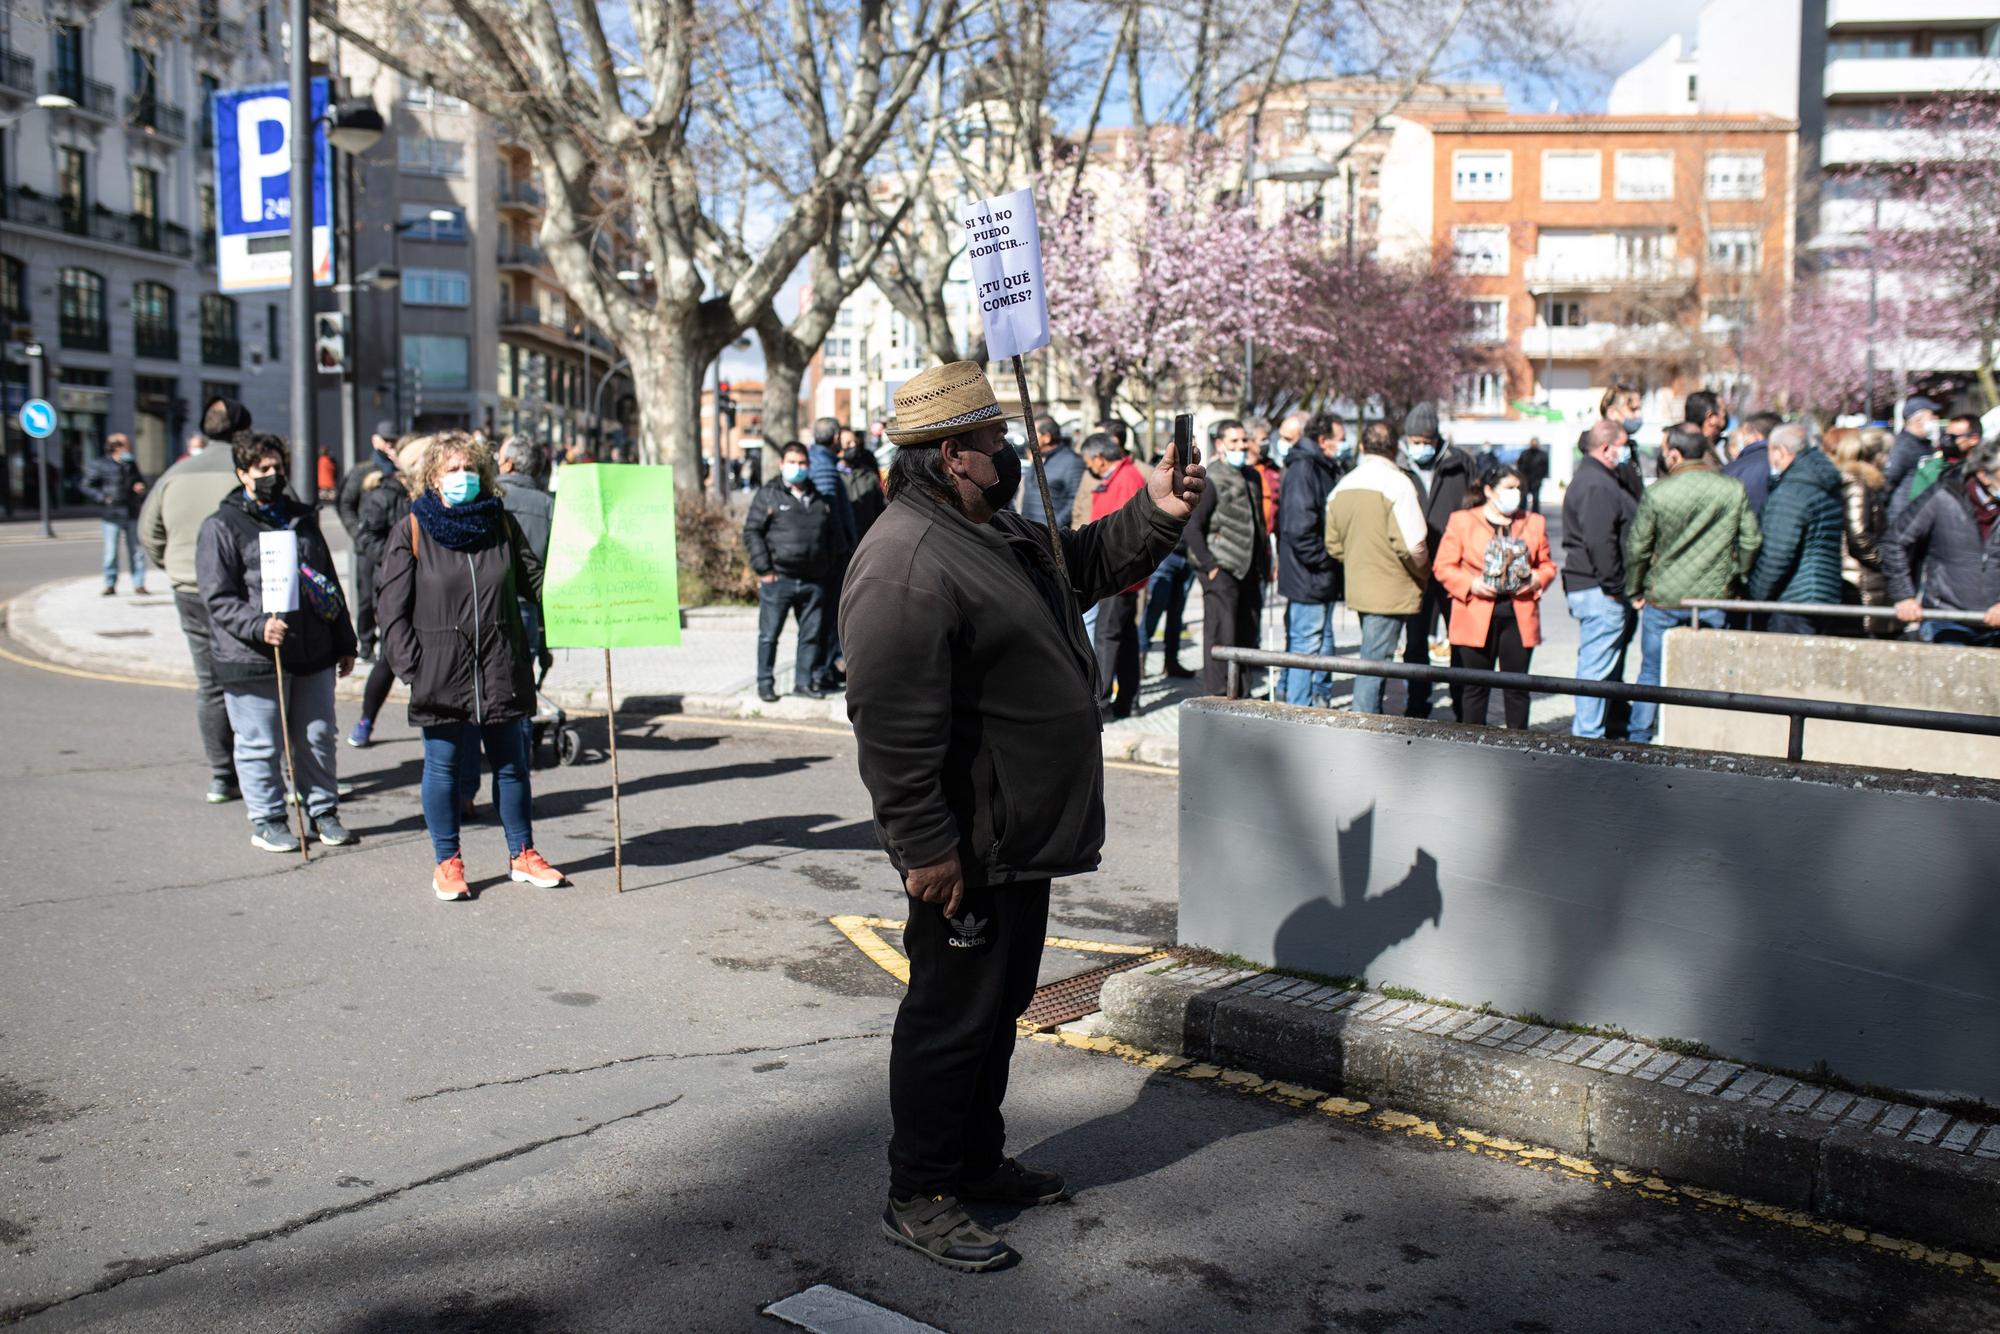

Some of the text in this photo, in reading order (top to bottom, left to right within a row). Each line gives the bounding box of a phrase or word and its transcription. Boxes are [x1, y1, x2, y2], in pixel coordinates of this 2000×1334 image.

[237, 96, 291, 223] P
[965, 209, 1013, 230] SI YO NO
[973, 225, 1010, 242] PUEDO
[969, 239, 1029, 258] RODUCIR...
[978, 271, 1031, 299] ¿TU QUÉ
[983, 290, 1032, 312] COMES?
[948, 937, 986, 948] adidas
